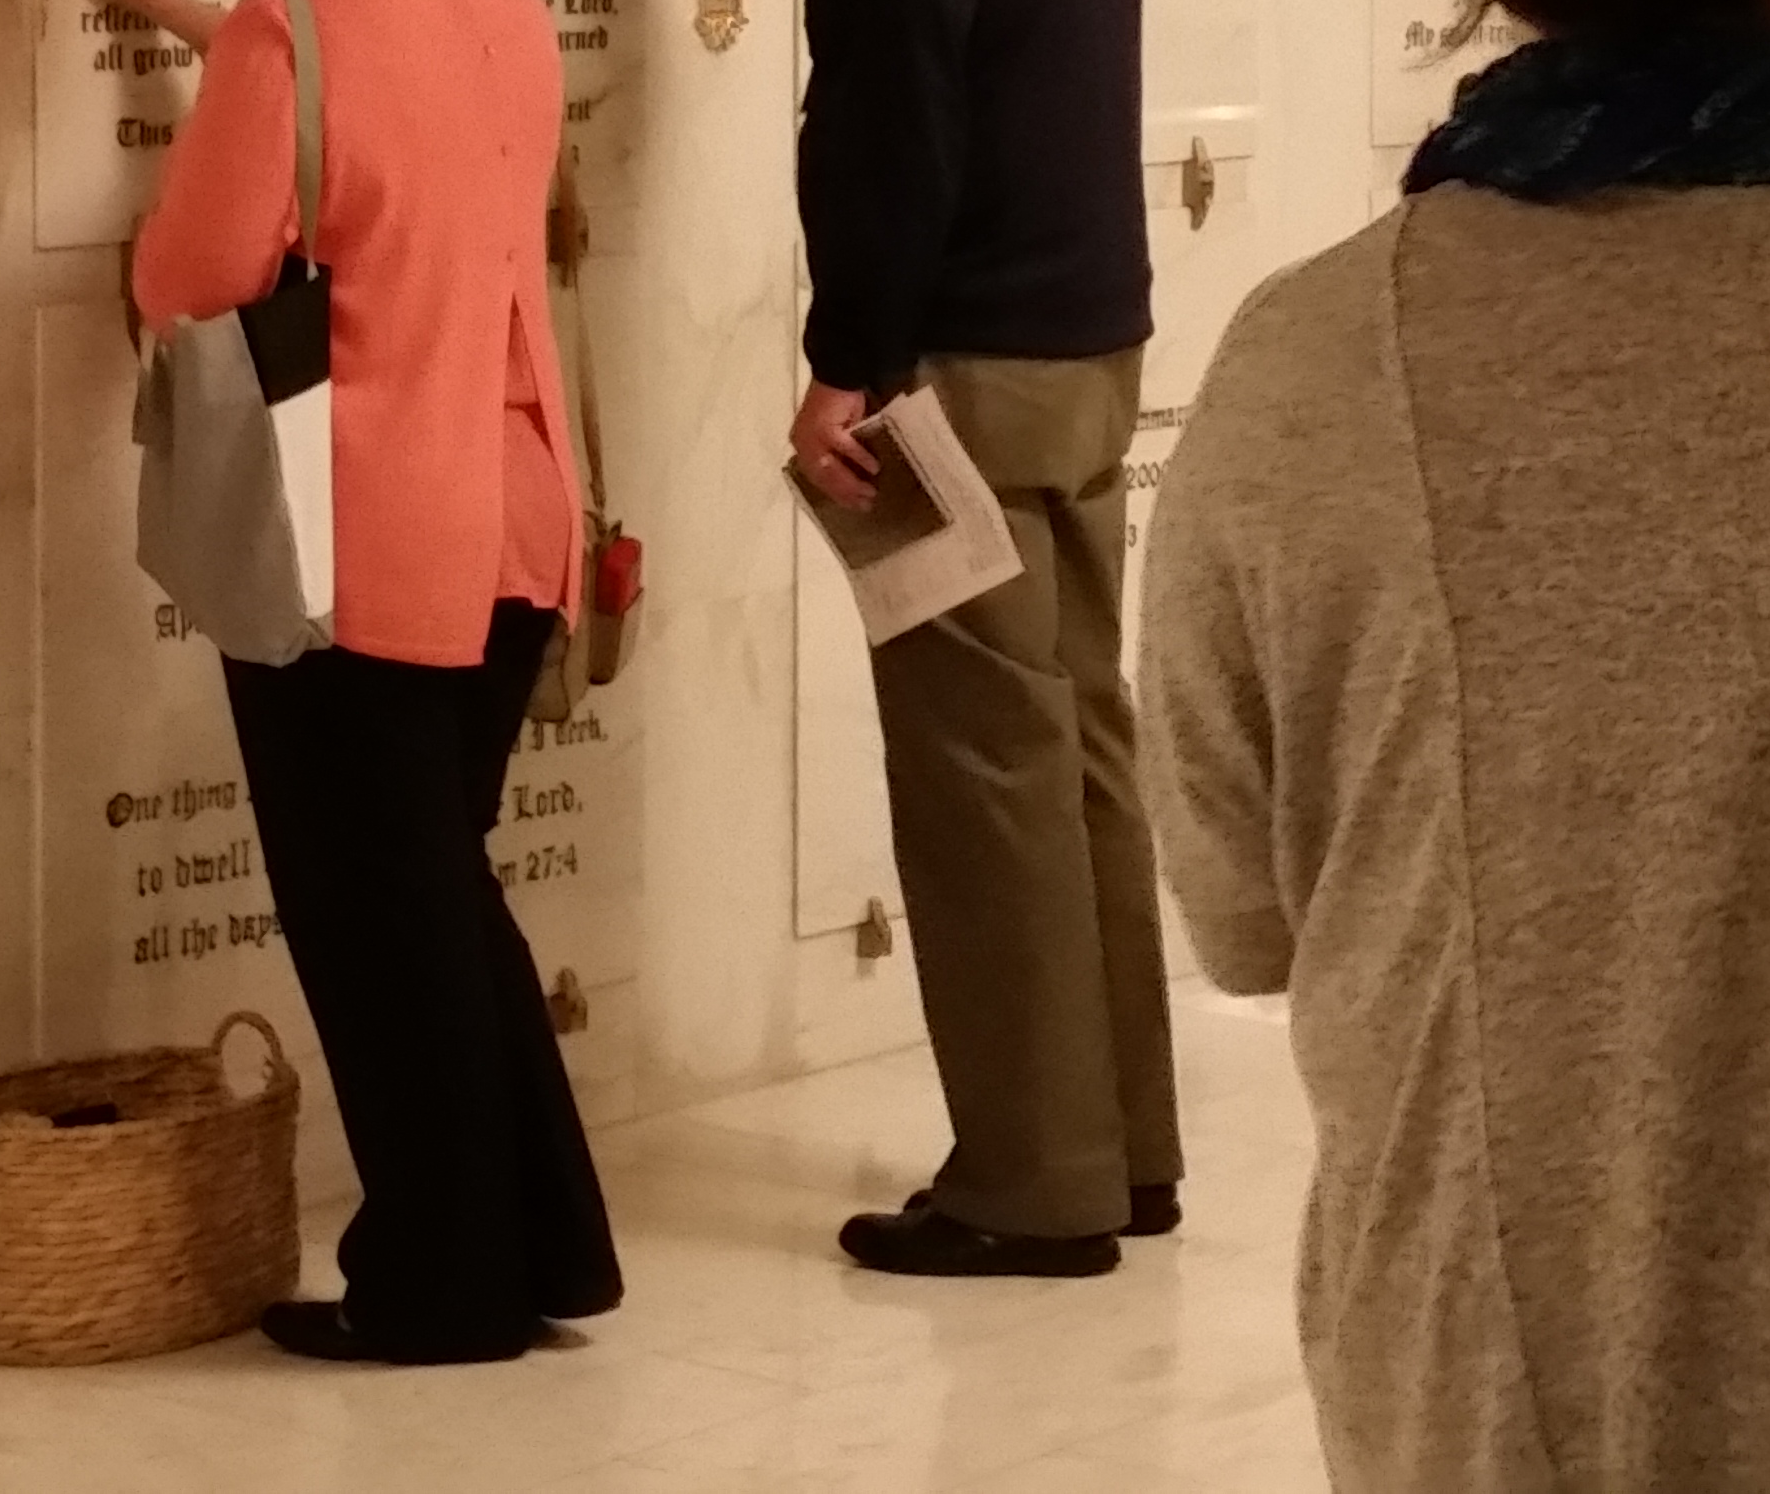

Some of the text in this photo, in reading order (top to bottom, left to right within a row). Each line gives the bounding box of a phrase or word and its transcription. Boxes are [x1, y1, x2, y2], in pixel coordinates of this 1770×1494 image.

[93, 42, 124, 72] all
[116, 116, 174, 148] This
[106, 778, 238, 829] One thing
[137, 862, 163, 898] to
[175, 838, 251, 889] dwell
[133, 924, 170, 965] all
[180, 917, 219, 961] the
[526, 842, 578, 882] 27:4
